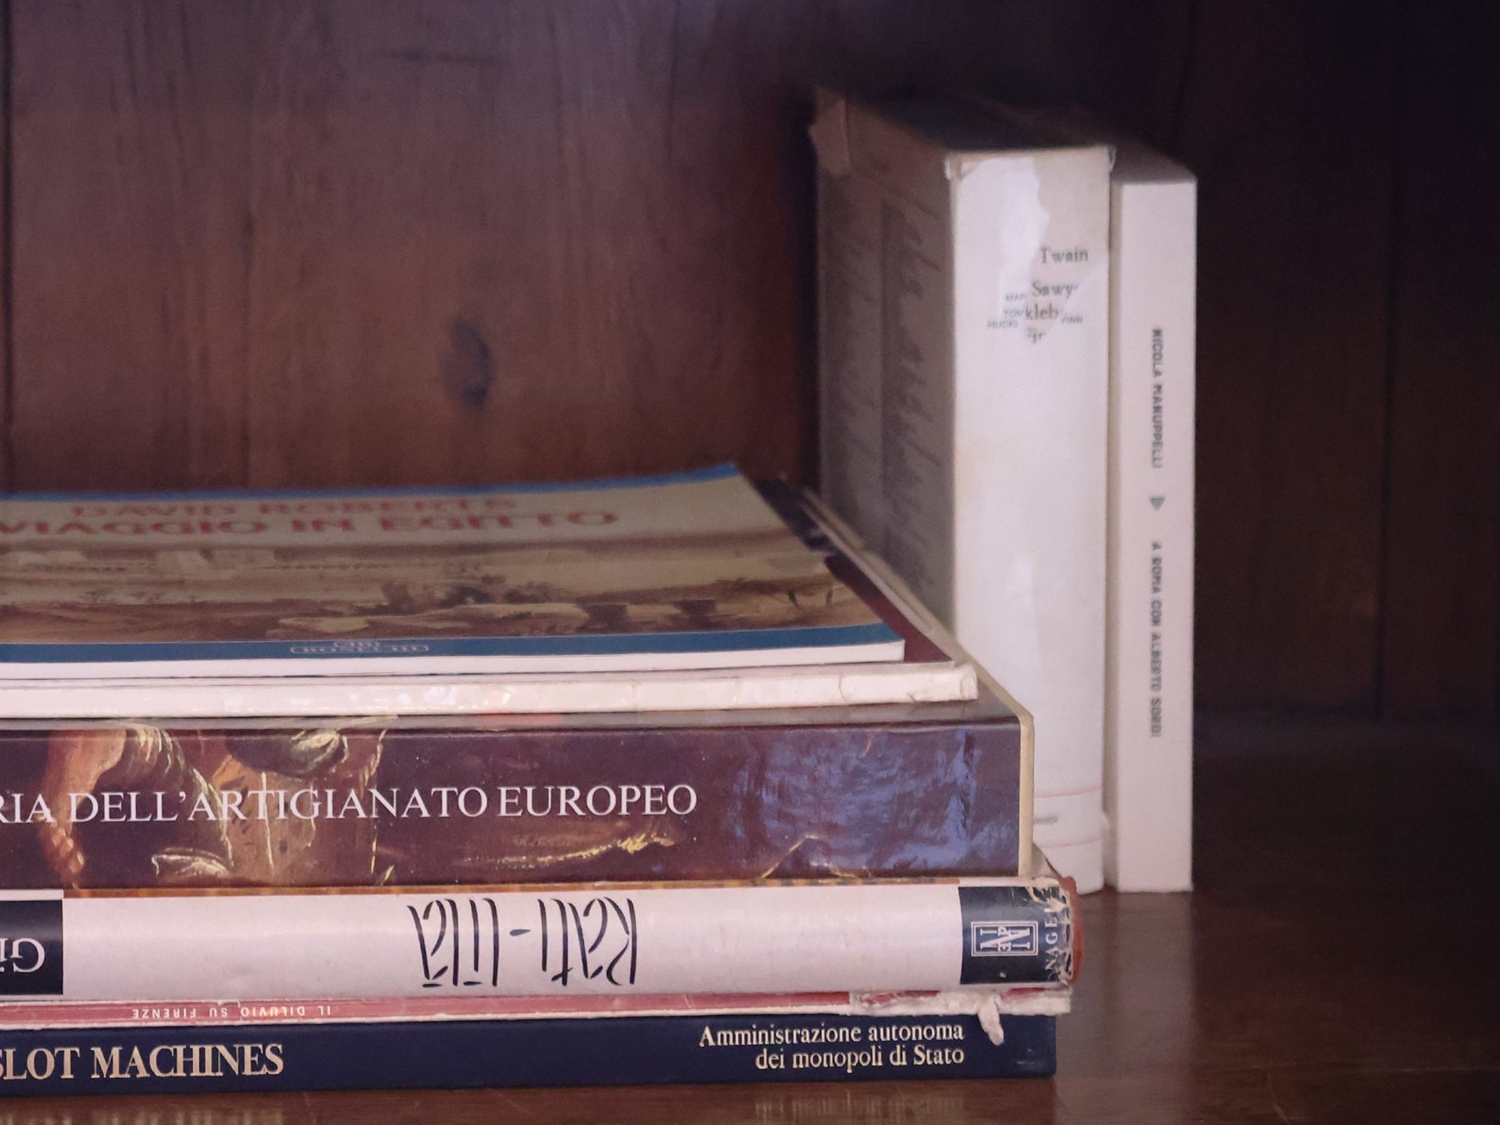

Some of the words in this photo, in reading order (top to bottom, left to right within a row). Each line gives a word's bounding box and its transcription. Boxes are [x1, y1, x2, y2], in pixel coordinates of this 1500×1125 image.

[1039, 246, 1089, 264] Twain
[1151, 328, 1164, 378] NICOLA
[1150, 556, 1163, 594] ROMA
[1150, 599, 1163, 627] CON
[67, 786, 490, 825] DELL'ARTIGIANATO
[496, 783, 698, 818] EUROPEO
[131, 1007, 197, 1020] FIRENZE
[208, 1006, 228, 1018] SU
[239, 1005, 306, 1018] DILUVIO
[317, 1004, 332, 1017] IL
[698, 1022, 862, 1048] Amministrazione
[867, 1020, 965, 1042] autonoma
[91, 1043, 285, 1079] MACHINES
[755, 1047, 786, 1071] dei
[792, 1045, 884, 1074] monopoli
[888, 1044, 908, 1067] di
[912, 1042, 965, 1067] Stato
